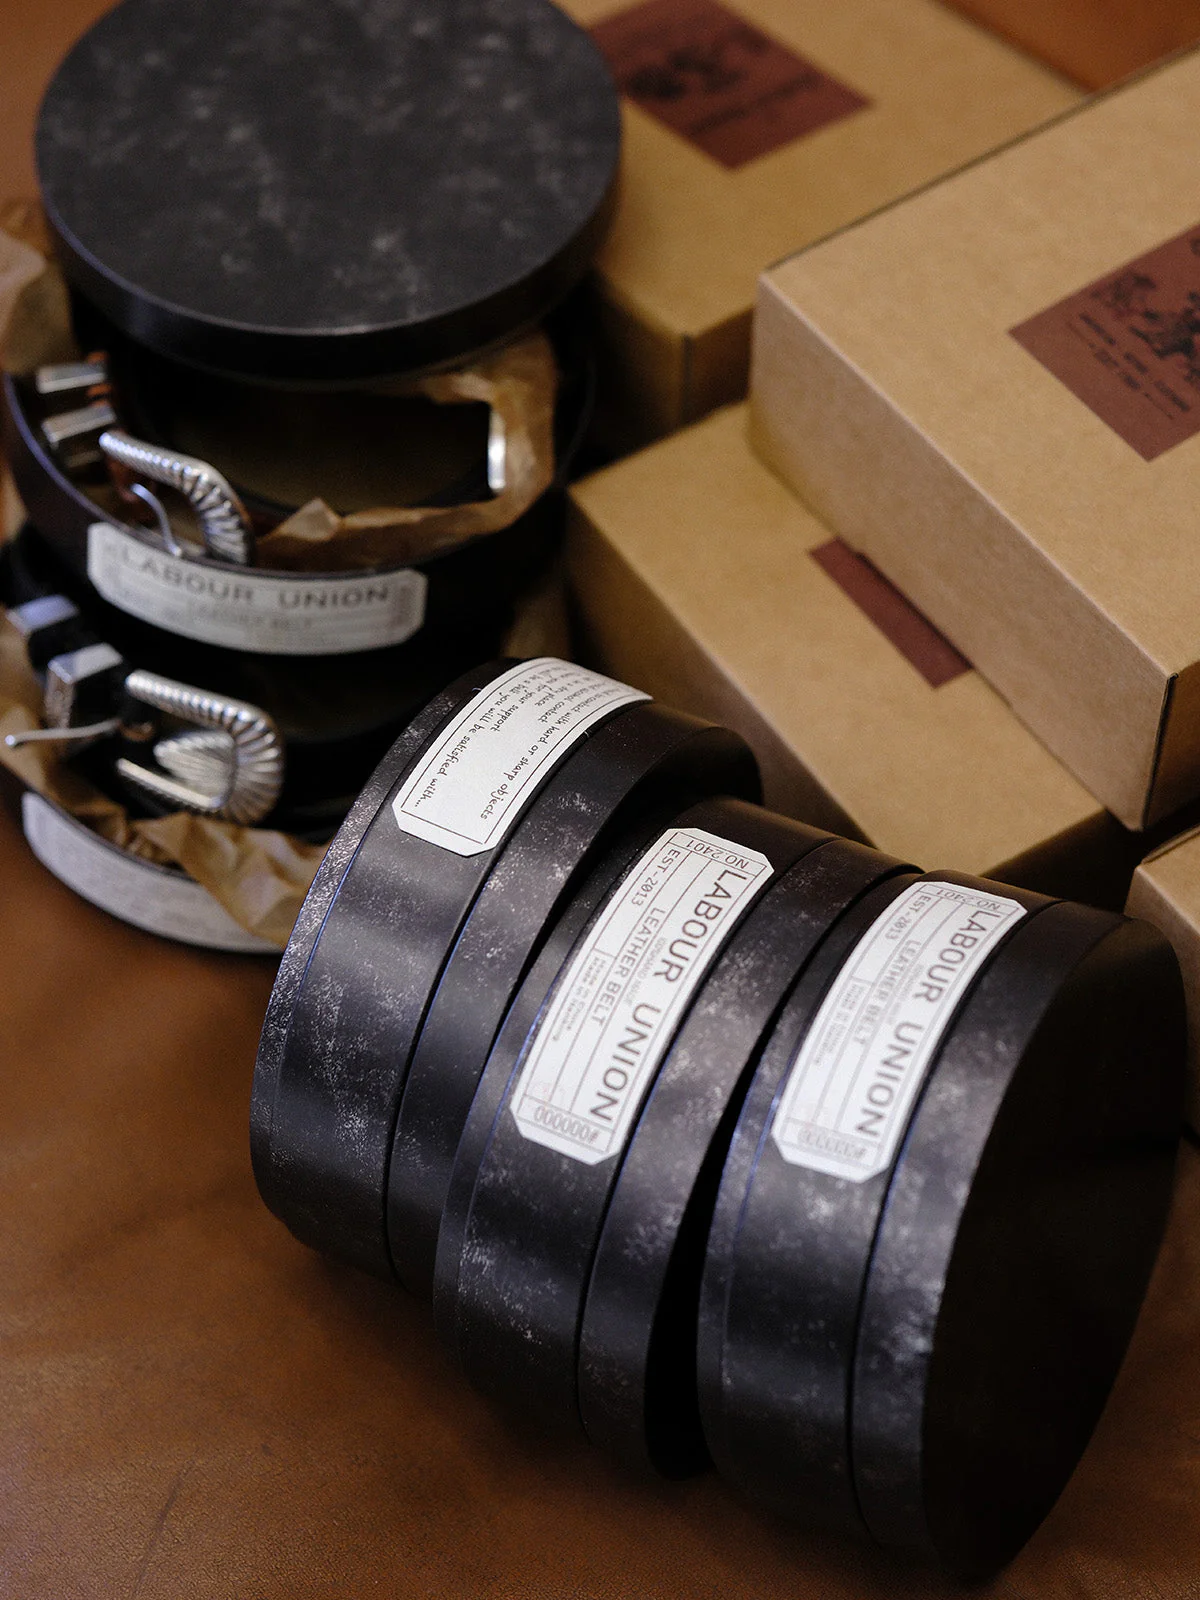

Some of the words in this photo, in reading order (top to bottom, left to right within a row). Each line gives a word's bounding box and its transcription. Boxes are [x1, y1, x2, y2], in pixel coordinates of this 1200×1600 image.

[277, 585, 390, 610] UNION
[495, 692, 510, 706] you
[519, 689, 533, 705] your
[476, 707, 496, 726] will
[491, 704, 519, 732] support
[538, 701, 565, 724] contact
[555, 712, 572, 725] with
[468, 722, 485, 735] be
[538, 726, 560, 745] hard
[437, 736, 474, 777] satisfied
[528, 744, 539, 756] or
[503, 755, 529, 783] sharp
[481, 783, 509, 820] objects
[654, 869, 747, 983] LABOUR
[615, 907, 666, 978] LEATHER
[914, 910, 1000, 1003] LABOUR
[590, 981, 622, 1027] BELT
[590, 1003, 661, 1121] UNION
[856, 1021, 923, 1137] UNION
